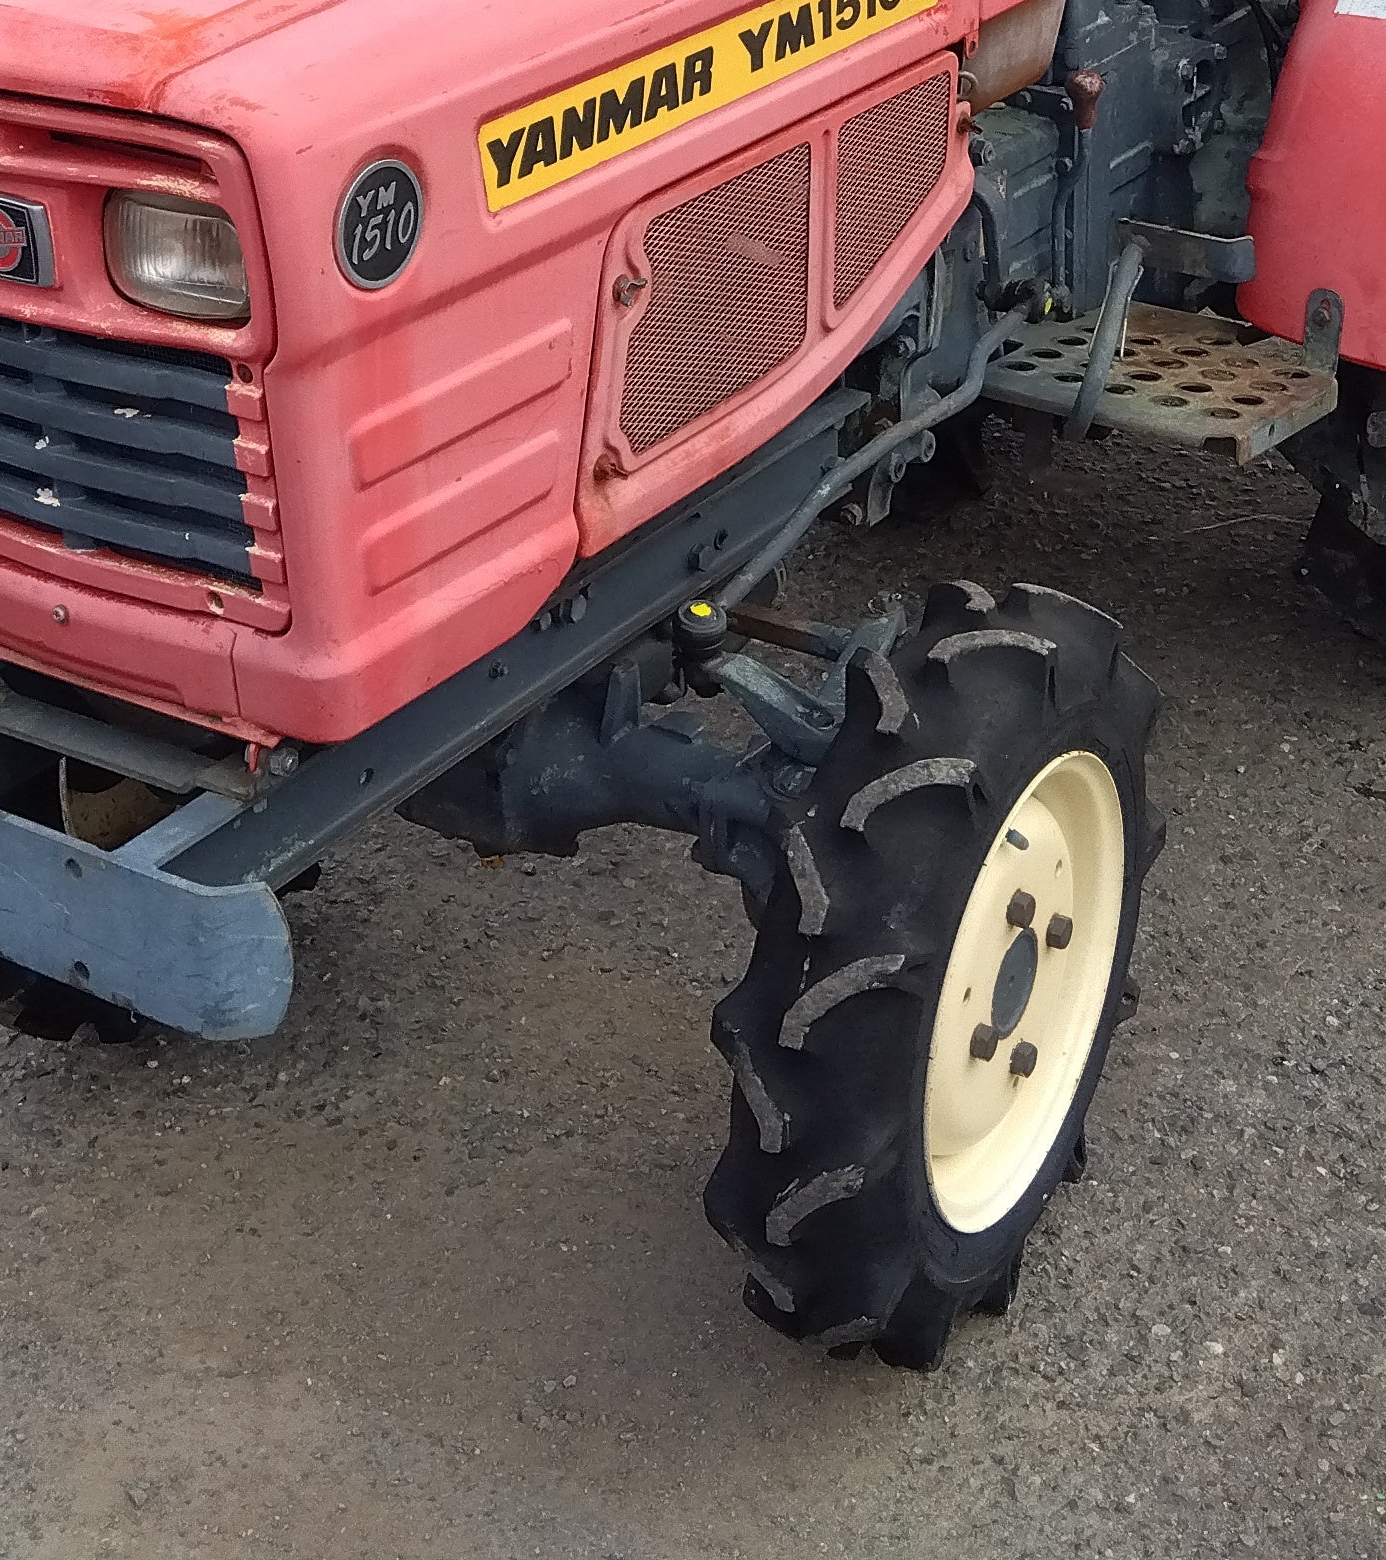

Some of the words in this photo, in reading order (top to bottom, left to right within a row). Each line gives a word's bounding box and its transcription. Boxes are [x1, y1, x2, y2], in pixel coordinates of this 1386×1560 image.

[486, 45, 715, 189] YANMAR
[355, 181, 397, 217] YM
[352, 201, 415, 265] 1510
